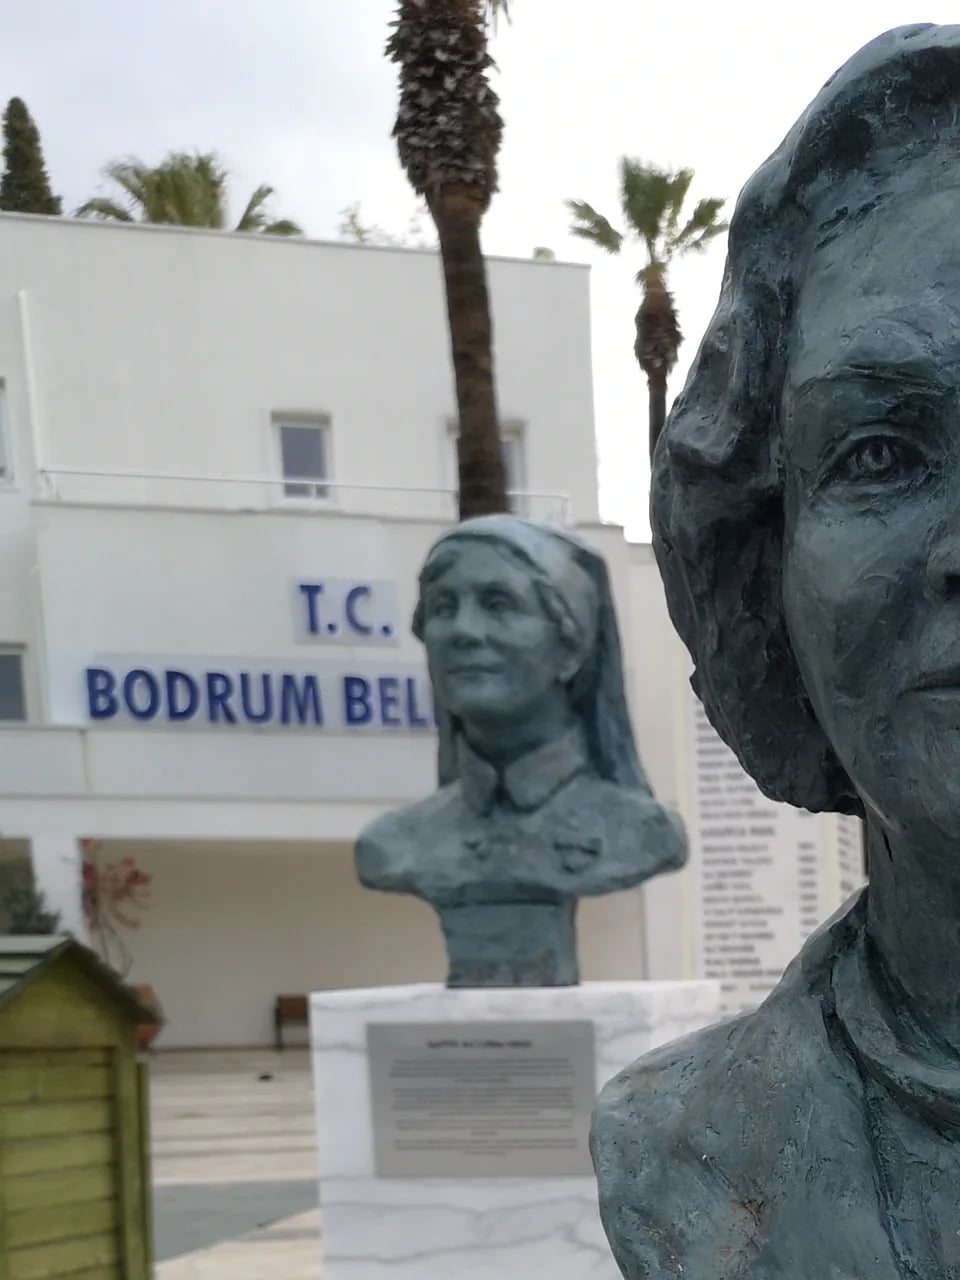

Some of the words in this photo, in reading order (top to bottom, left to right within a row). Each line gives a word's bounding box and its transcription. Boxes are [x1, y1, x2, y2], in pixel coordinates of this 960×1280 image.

[299, 583, 393, 637] T.C.
[86, 667, 324, 727] BODRUM
[343, 675, 439, 728] BEL
